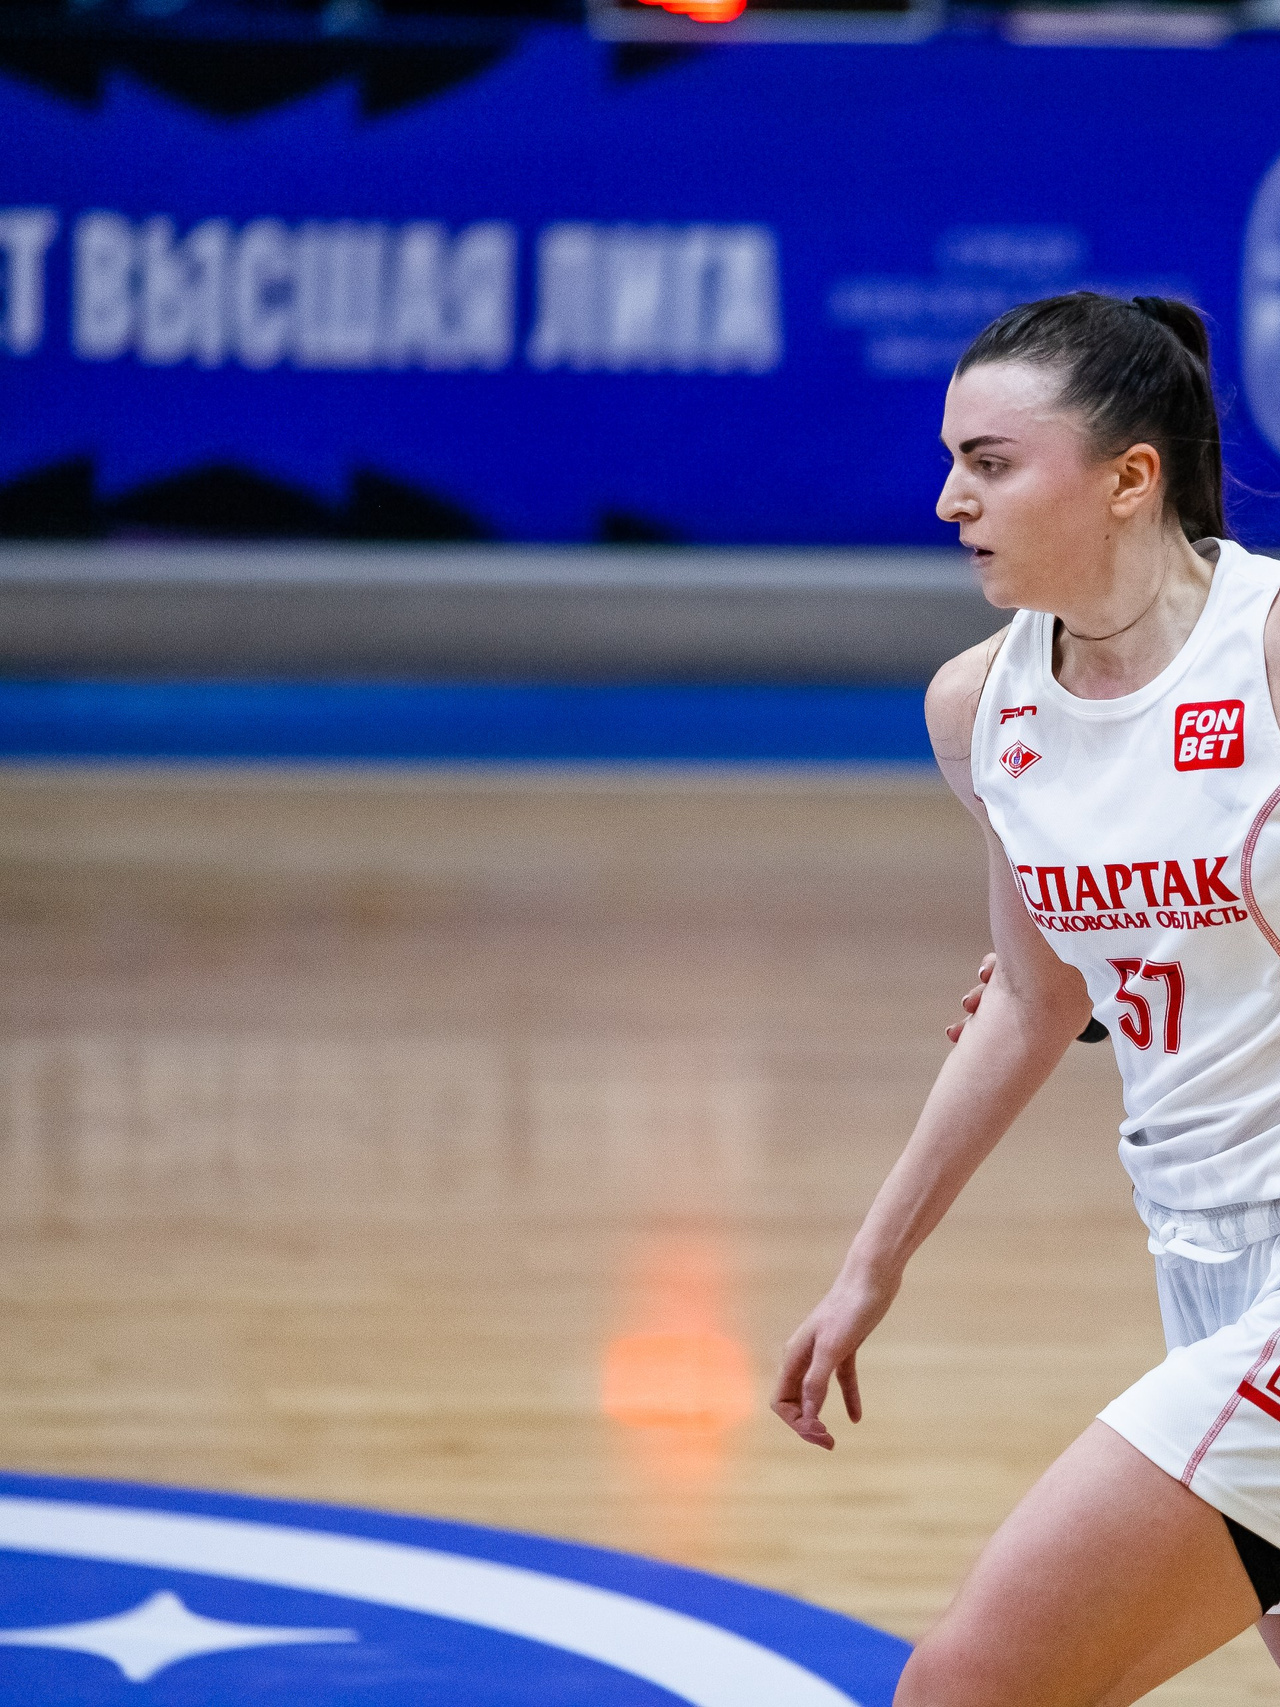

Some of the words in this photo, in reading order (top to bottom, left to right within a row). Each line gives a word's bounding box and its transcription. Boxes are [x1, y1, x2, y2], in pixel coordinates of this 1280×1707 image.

[74, 212, 516, 370] ВЫСШАЯ
[528, 223, 782, 373] ЛИГА
[1178, 708, 1240, 735] FON
[1178, 733, 1239, 763] BET
[1017, 856, 1240, 912] СПАРТАК
[1156, 905, 1248, 930] ОБЛАСТЬ
[1106, 957, 1186, 1054] 57
